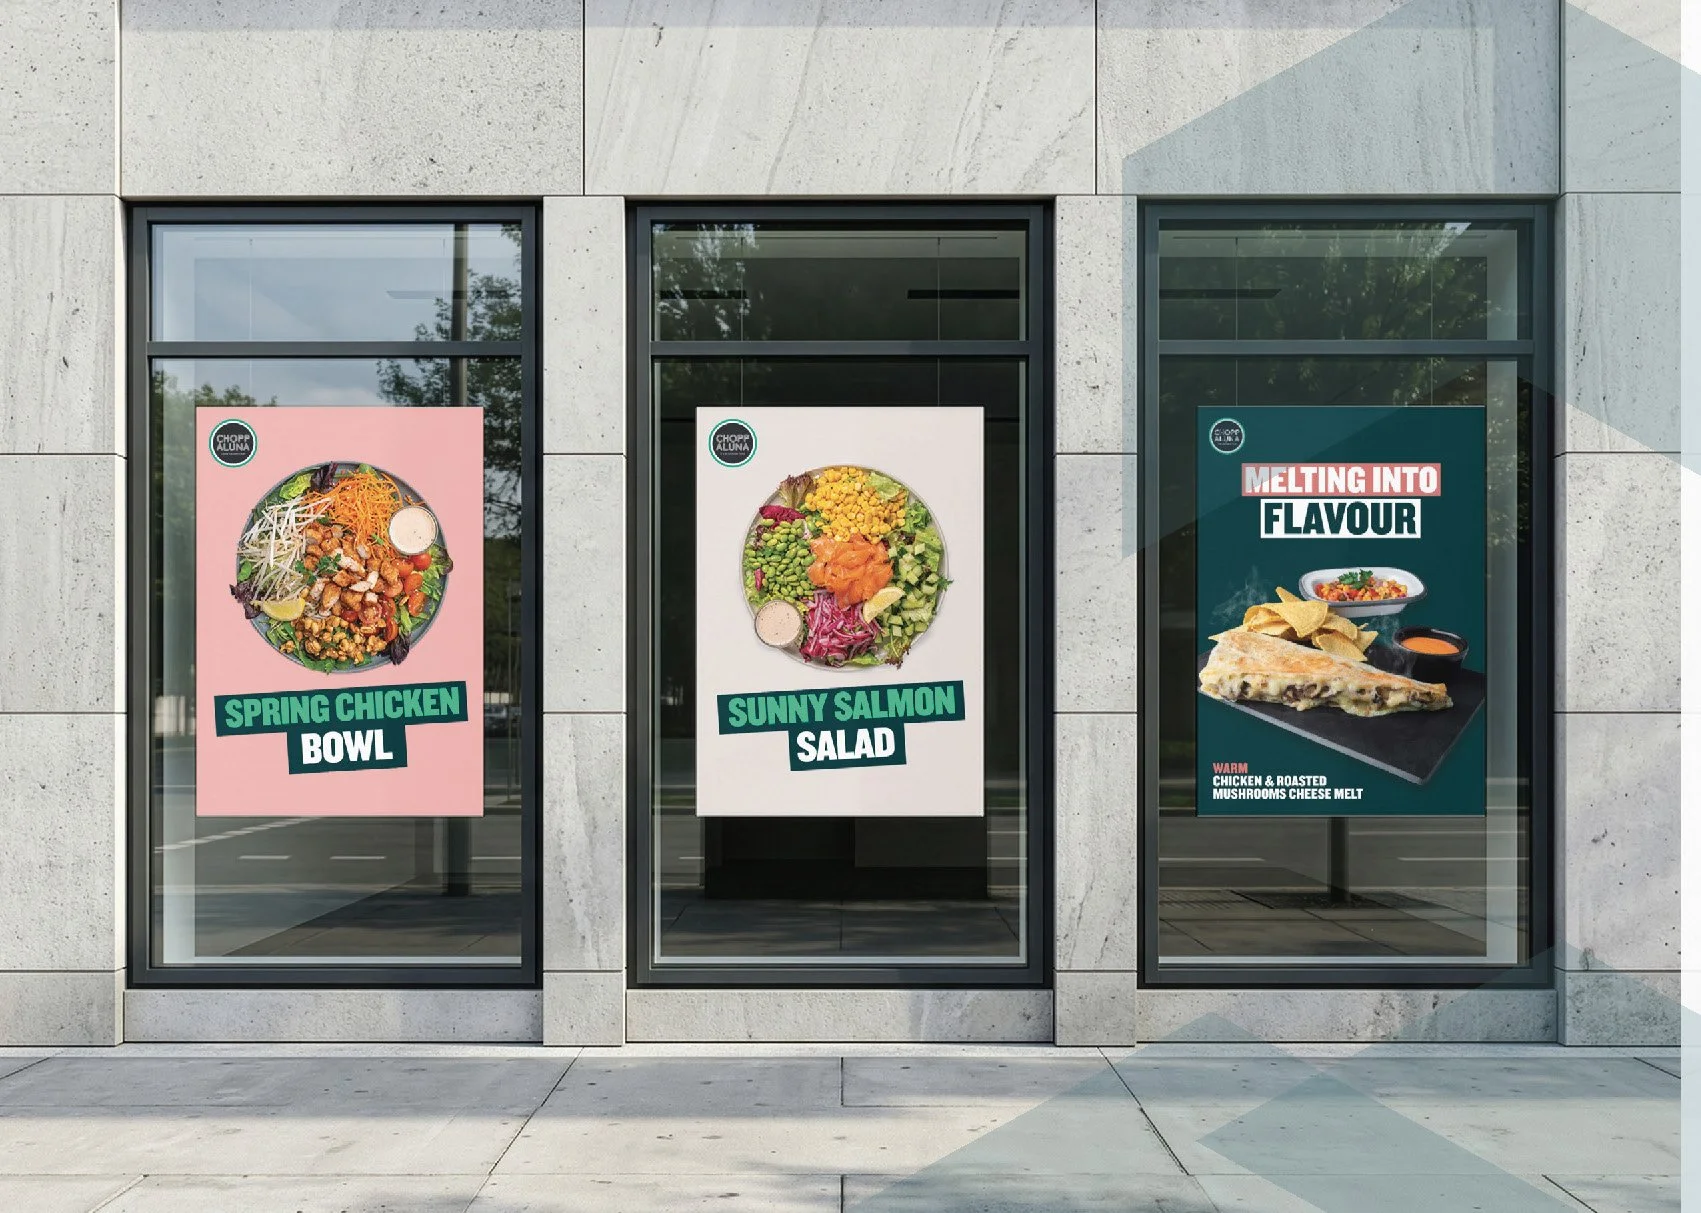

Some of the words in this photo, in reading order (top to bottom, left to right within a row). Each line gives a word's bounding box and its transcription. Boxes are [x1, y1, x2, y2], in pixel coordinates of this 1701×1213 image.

[216, 434, 250, 443] CHOPP
[715, 434, 750, 443] CHOPP
[216, 442, 250, 451] ALUNA
[715, 442, 750, 451] ALUNA
[1245, 466, 1366, 494] MELTING
[1372, 466, 1438, 494] INTO
[1264, 501, 1417, 535] FLAVOUR
[224, 694, 330, 729] SPRING
[335, 686, 460, 722] CHICKEN
[728, 692, 828, 728] SUNNY
[833, 685, 956, 722] SALMON
[301, 729, 394, 765] BOWL
[796, 727, 895, 762] SALAD
[1212, 762, 1248, 774] WARM
[1212, 775, 1262, 786] CHICKEN
[1264, 775, 1274, 787] &
[1276, 775, 1327, 786] ROASTED
[1212, 788, 1286, 799] MUSHROOMS
[1289, 788, 1331, 799] CHEESE
[1334, 788, 1363, 799] MELT
